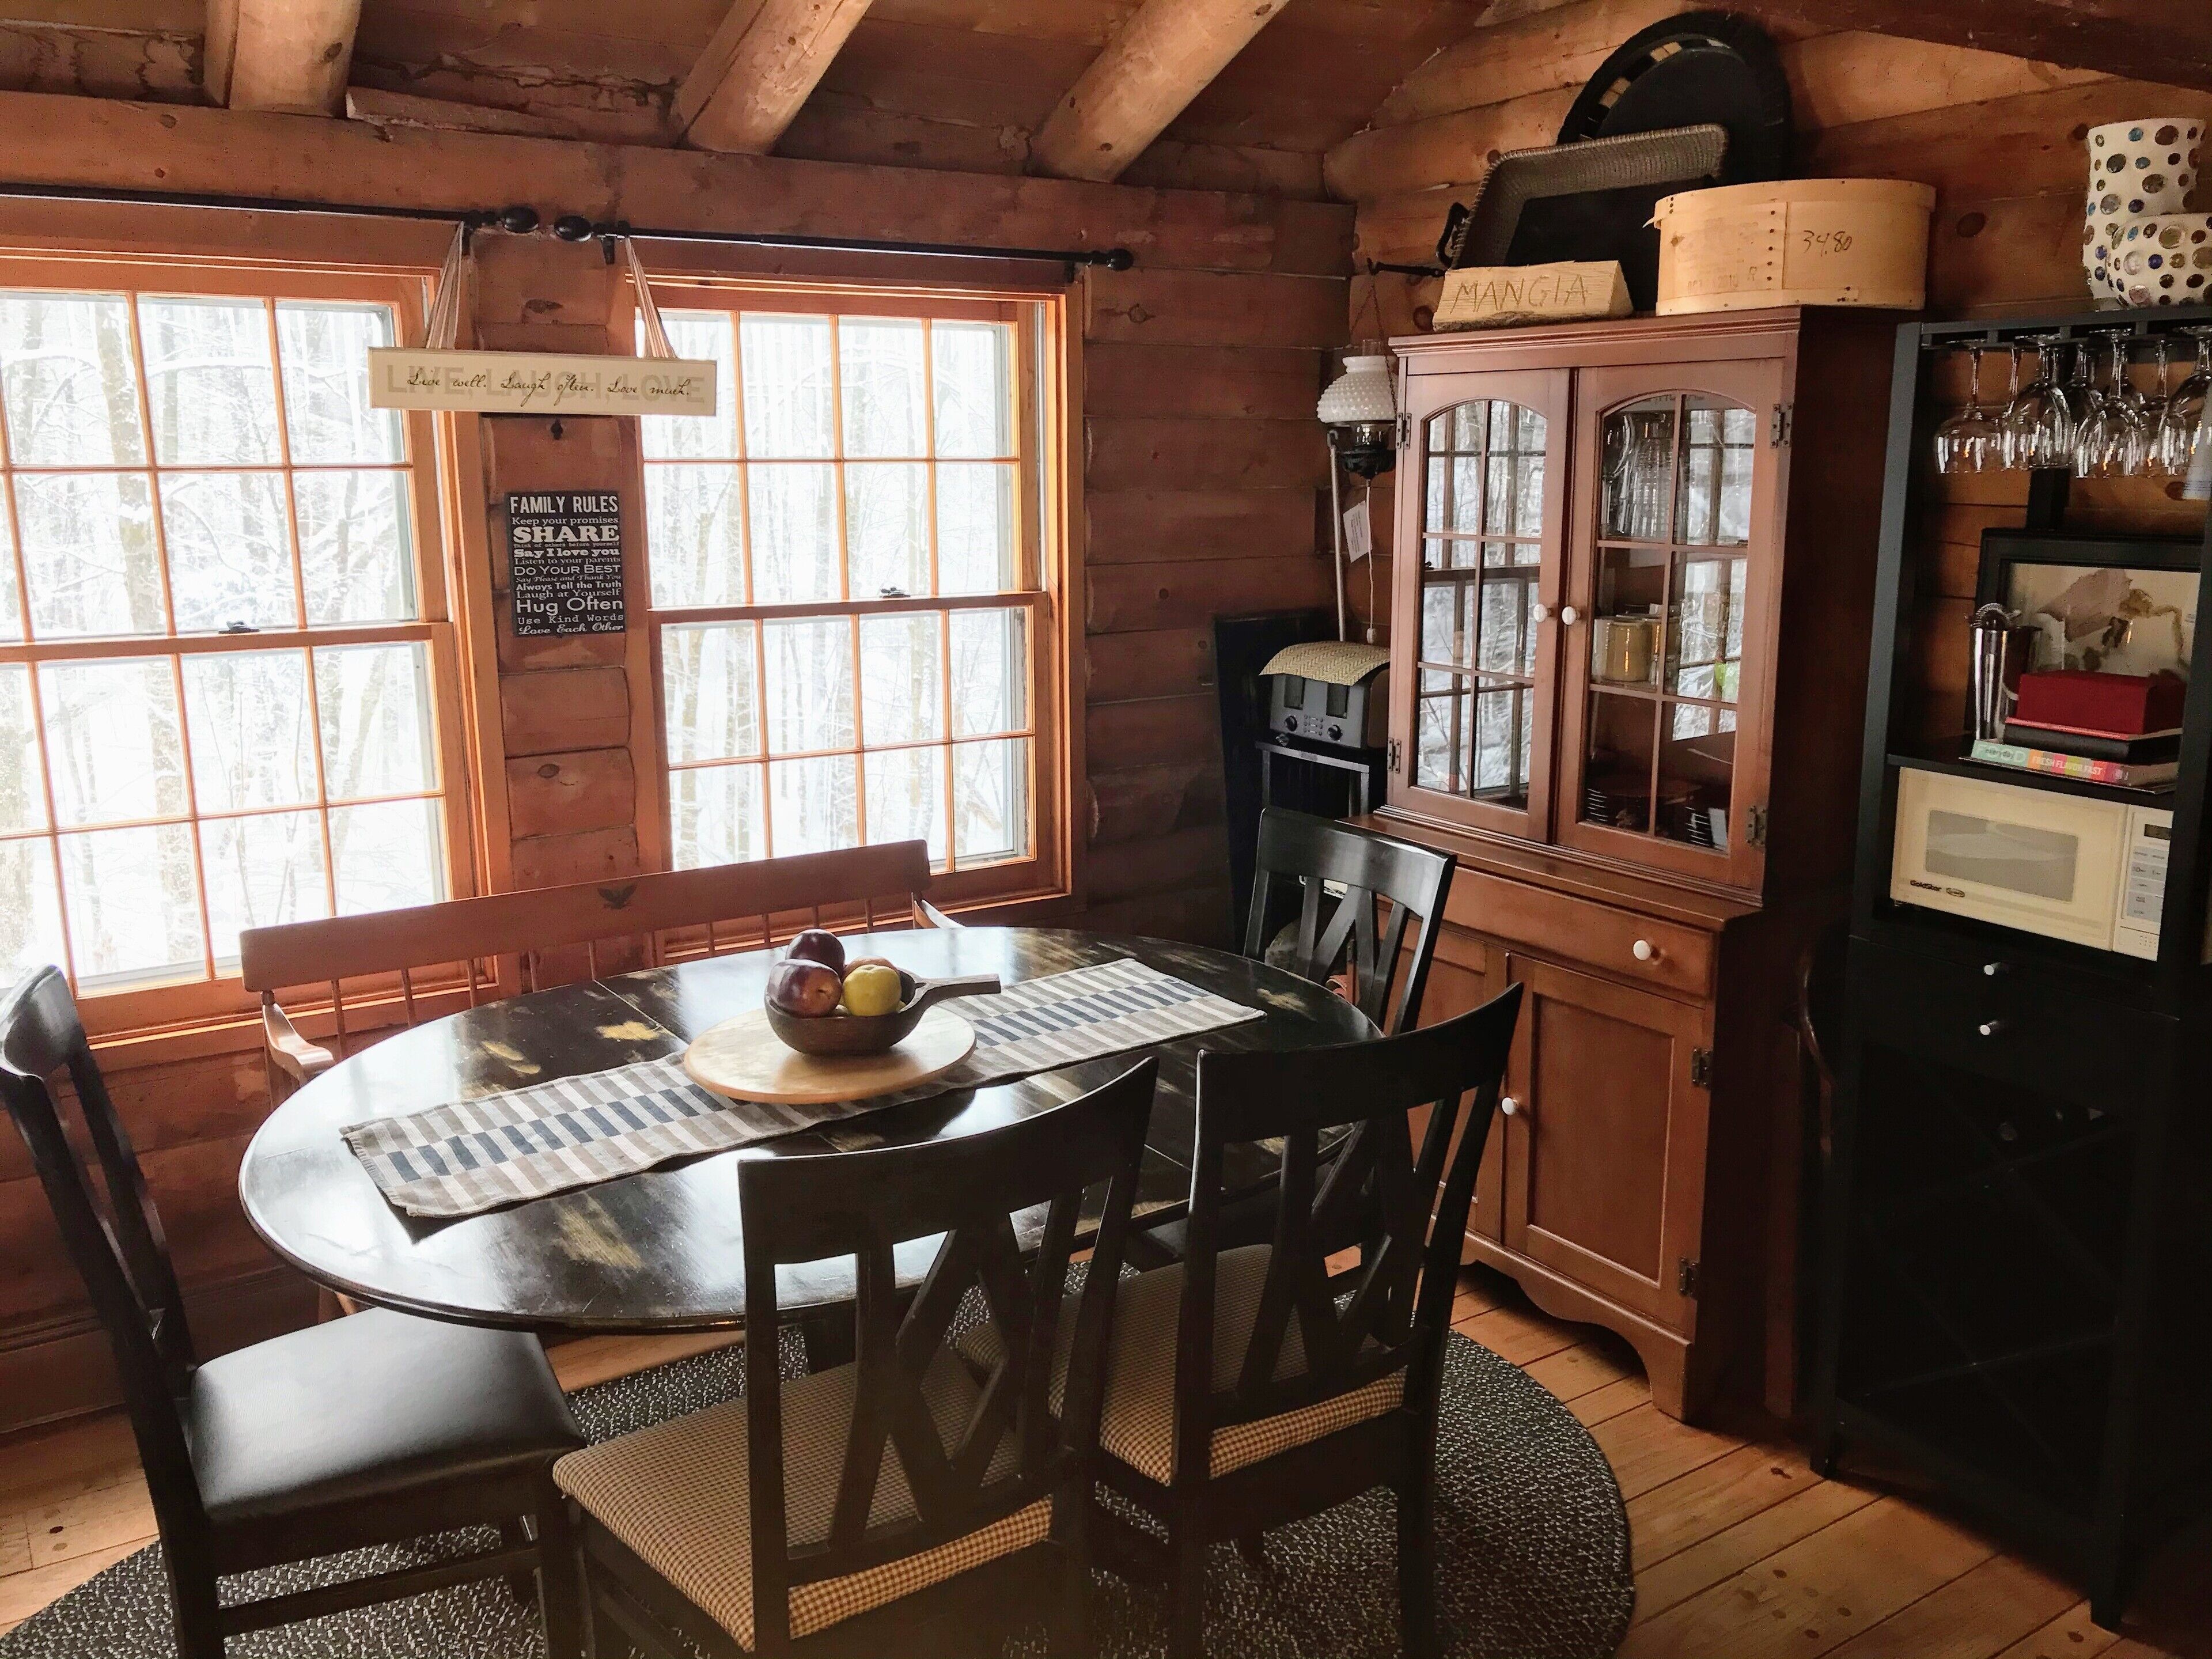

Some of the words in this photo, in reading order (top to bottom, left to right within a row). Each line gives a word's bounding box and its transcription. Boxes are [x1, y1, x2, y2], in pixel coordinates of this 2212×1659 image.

[1449, 274, 1589, 315] MANGIA
[407, 368, 440, 386] Live
[453, 374, 487, 387] well.
[501, 371, 551, 407] Laugh
[607, 376, 638, 393] Love
[650, 378, 691, 395] much.
[622, 374, 704, 403] LOVE
[510, 496, 565, 514] FAMILY
[573, 495, 618, 513] RULES
[512, 517, 539, 526] Keep
[542, 518, 567, 527] your
[570, 517, 619, 526] promises
[513, 525, 620, 543] SHARE
[514, 549, 544, 558] Say
[547, 548, 555, 556] I
[556, 548, 589, 557] love
[591, 548, 620, 557] you
[516, 577, 531, 585] Say
[516, 583, 552, 591] Always
[555, 581, 573, 589] Tell
[516, 590, 553, 600] Laugh
[573, 588, 622, 597] Yourself
[516, 599, 559, 616] Hug
[566, 596, 623, 611] Often
[548, 615, 579, 623] Kind
[586, 613, 623, 622] Words
[518, 625, 551, 635] Love
[556, 623, 588, 632] Each
[592, 622, 623, 631] Other
